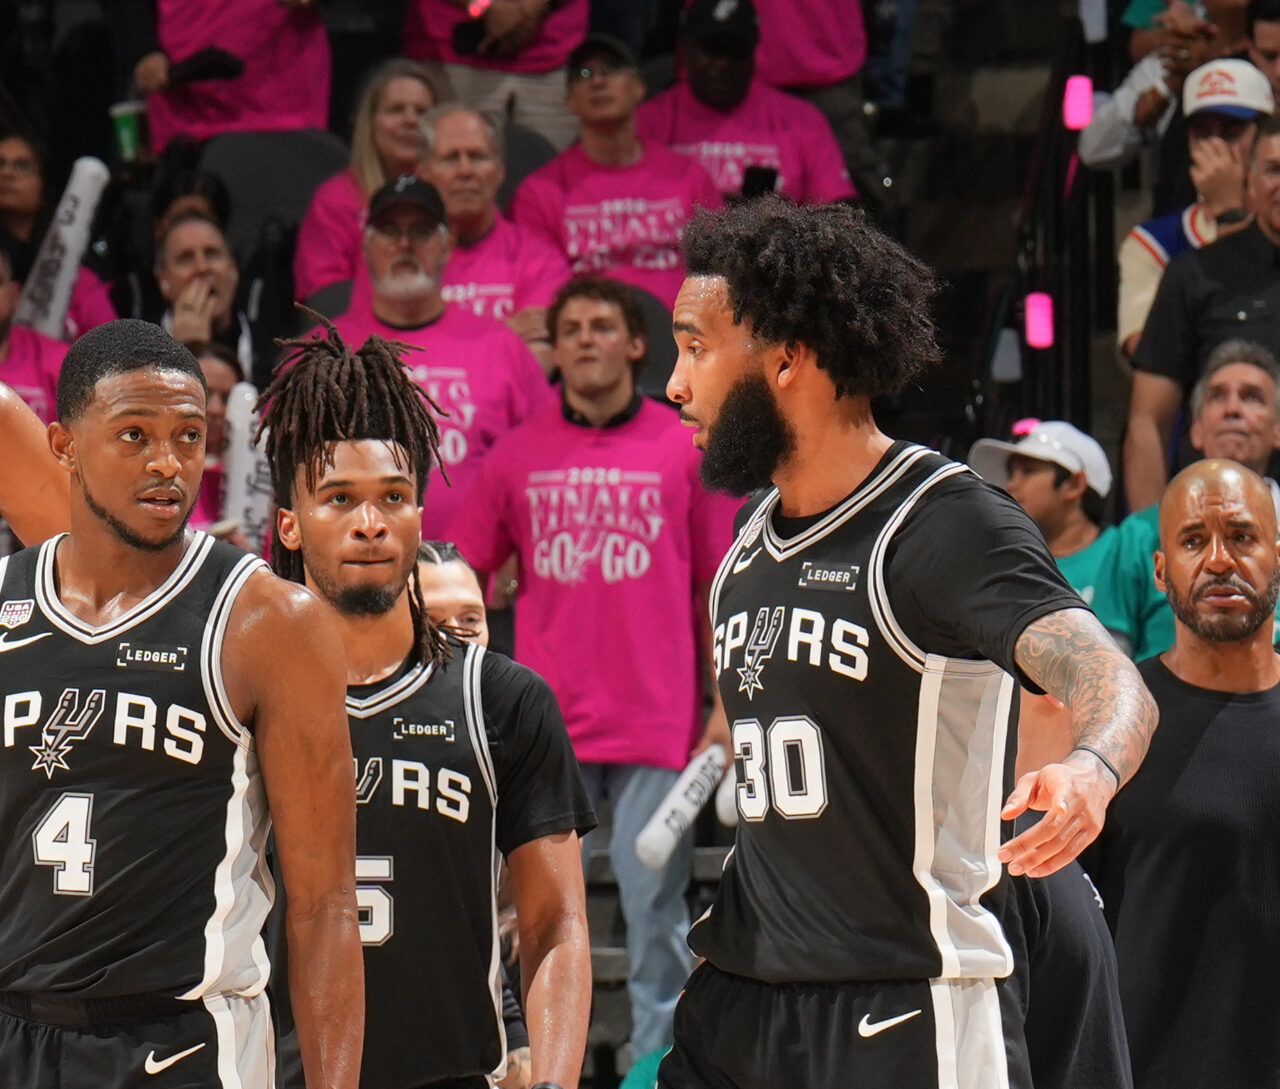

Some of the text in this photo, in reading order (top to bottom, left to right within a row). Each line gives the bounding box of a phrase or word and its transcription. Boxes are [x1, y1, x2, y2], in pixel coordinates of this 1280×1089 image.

[567, 466, 622, 486] 2026
[526, 485, 664, 545] FINALS
[533, 530, 651, 585] GO GO
[807, 568, 851, 583] LEDGER
[5, 602, 31, 612] USA
[125, 648, 178, 664] LEDGER
[714, 606, 870, 701] SPURS
[401, 723, 448, 736] LEDGER
[732, 714, 829, 823] 30
[32, 792, 97, 896] 4
